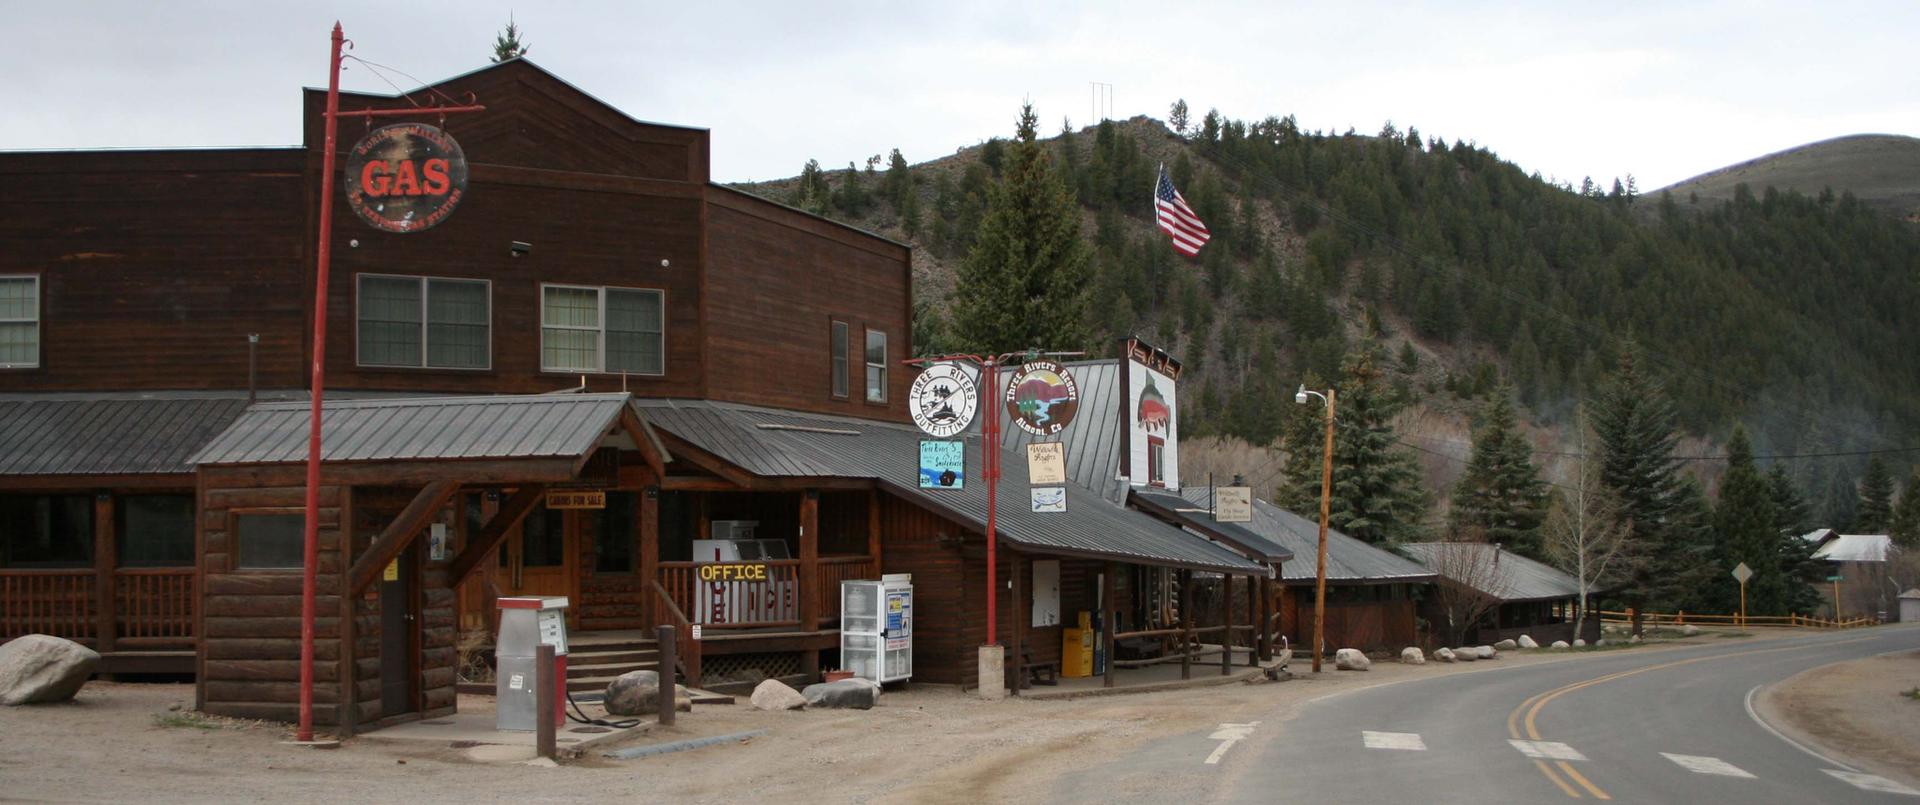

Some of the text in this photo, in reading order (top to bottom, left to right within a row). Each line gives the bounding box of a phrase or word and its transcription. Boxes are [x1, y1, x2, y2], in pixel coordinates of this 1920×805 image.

[361, 158, 451, 198] GAS
[911, 368, 976, 400] THREE RIVERS
[1006, 361, 1076, 402] Three Rivers Resort
[914, 413, 970, 436] OUTFITTING
[573, 495, 585, 505] FOR
[587, 495, 603, 505] SALE
[701, 564, 767, 580] OFFICE
